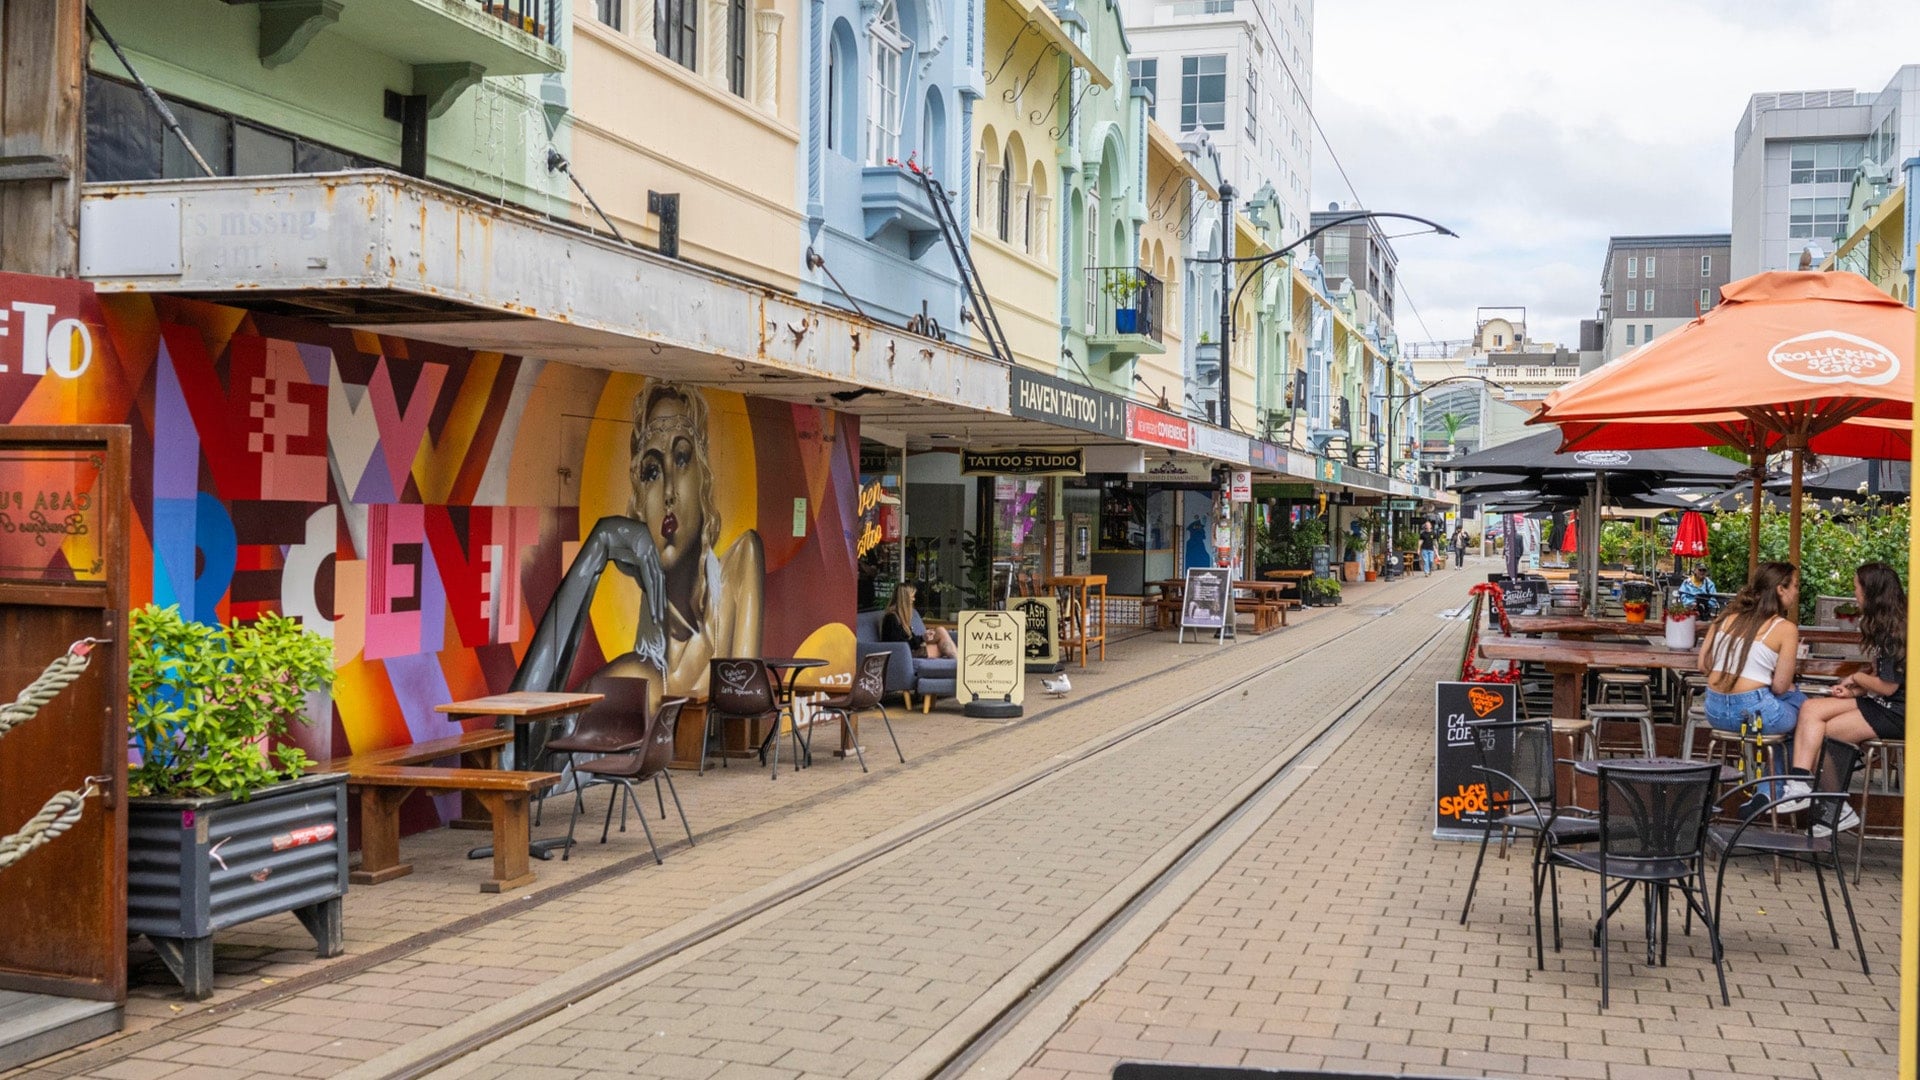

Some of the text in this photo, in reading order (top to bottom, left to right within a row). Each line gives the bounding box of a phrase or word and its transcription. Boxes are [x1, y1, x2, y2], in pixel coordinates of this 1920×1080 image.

[1773, 347, 1887, 363] ROLLICKIN
[1019, 379, 1059, 415] HAVEN
[1059, 390, 1097, 424] TATTOO
[967, 455, 1078, 467] TATTOO STUDIO
[857, 481, 882, 517] ven
[857, 521, 882, 559] attoo
[971, 631, 1013, 641] WALK
[965, 653, 1014, 667] Welcome
[1447, 713, 1465, 728] C4
